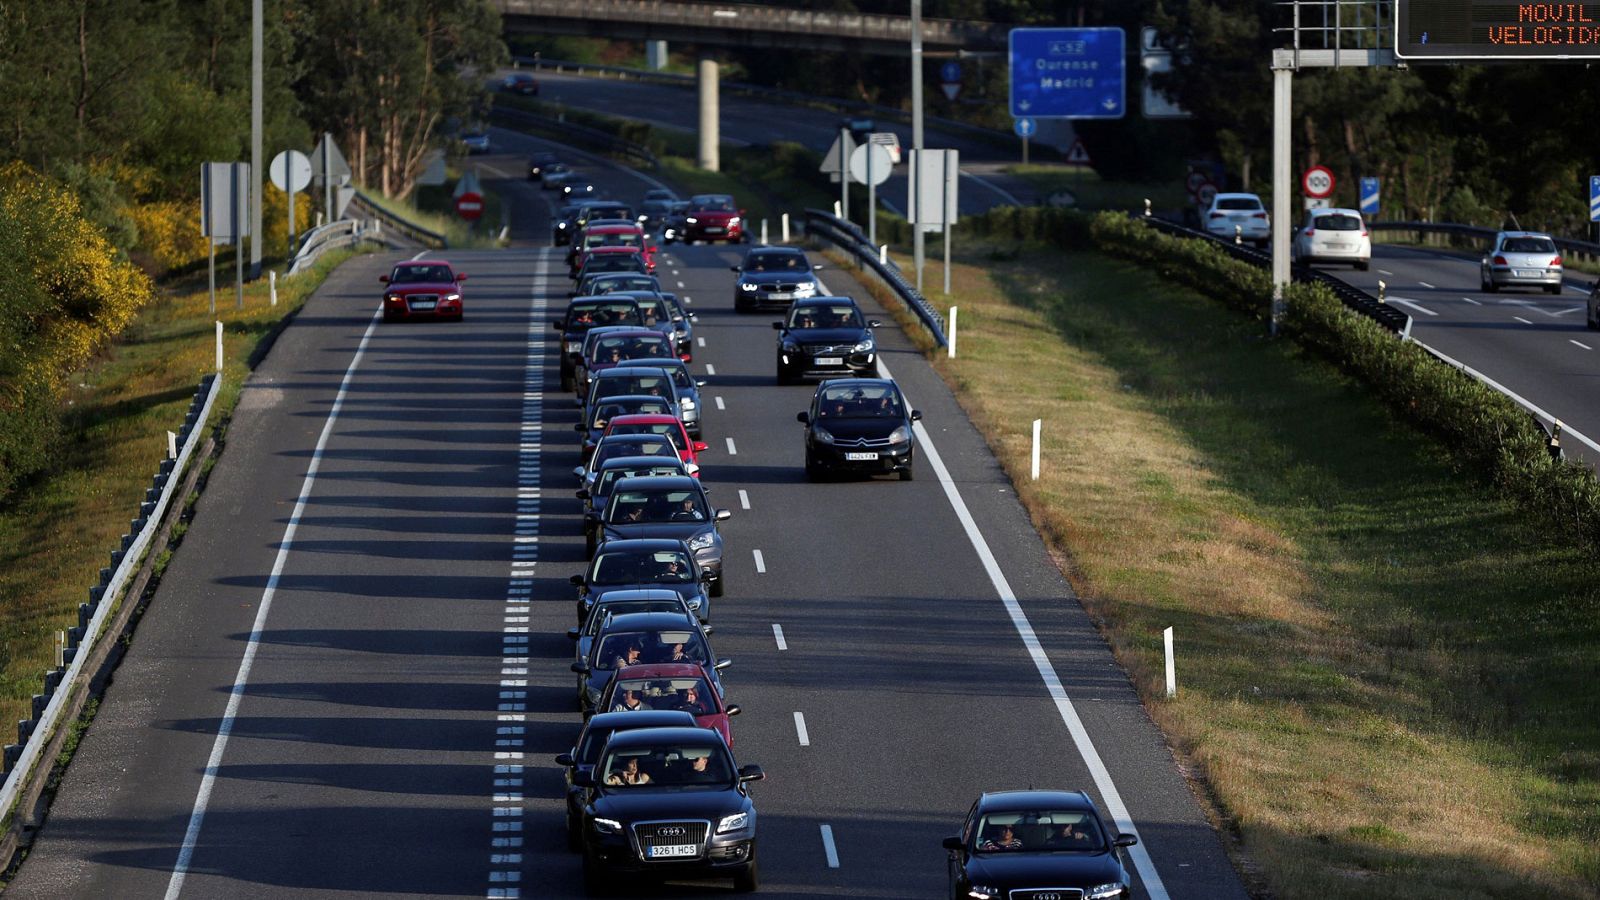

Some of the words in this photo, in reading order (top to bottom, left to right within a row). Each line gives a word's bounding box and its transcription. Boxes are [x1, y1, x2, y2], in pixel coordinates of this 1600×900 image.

[1519, 4, 1592, 22] MOVIL
[1051, 43, 1083, 53] A-52
[1036, 58, 1098, 70] Ourense
[1040, 77, 1093, 88] Madrid
[1308, 176, 1330, 188] 100
[653, 846, 675, 856] 3261
[678, 845, 695, 855] HCS
